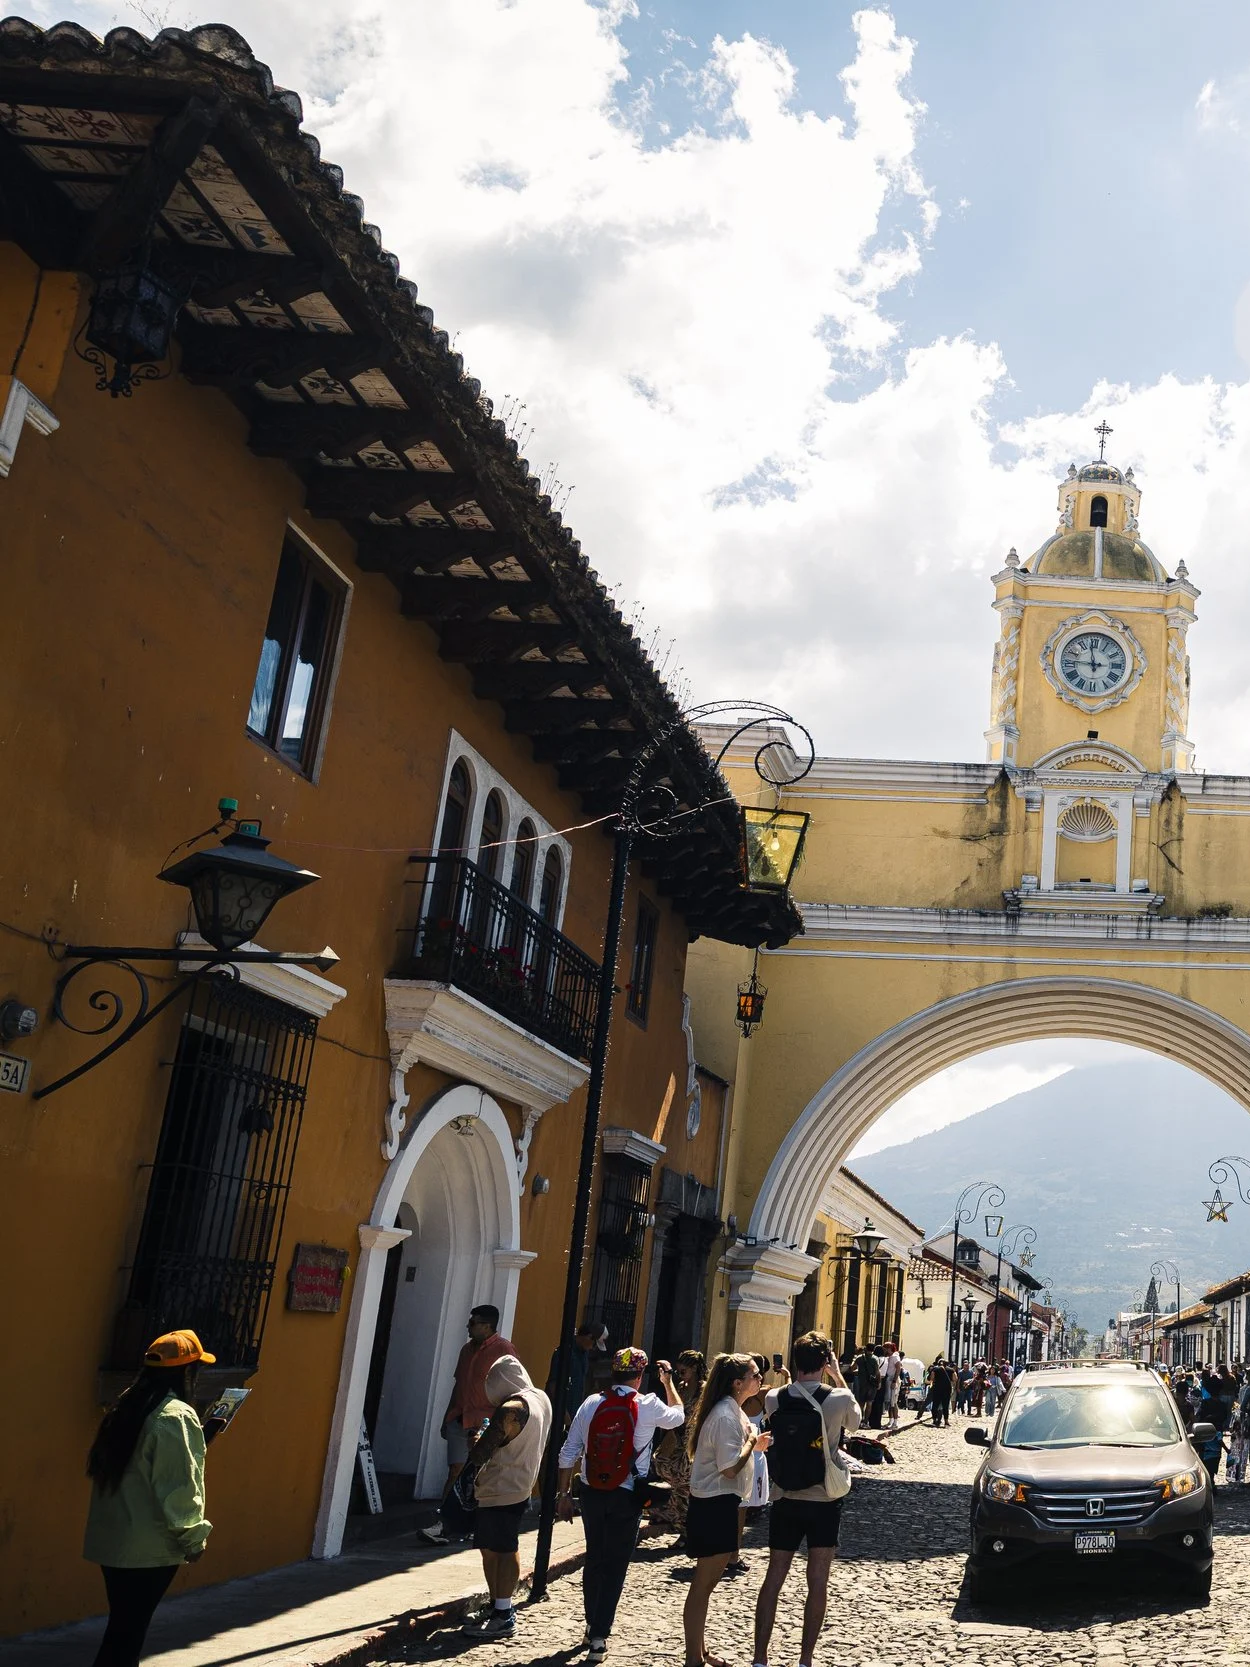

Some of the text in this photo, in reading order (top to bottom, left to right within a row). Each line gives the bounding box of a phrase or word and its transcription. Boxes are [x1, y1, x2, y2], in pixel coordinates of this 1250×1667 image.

[1102, 642, 1110, 652] I
[0, 1061, 19, 1085] 5A
[1076, 1536, 1114, 1549] P978LJQ
